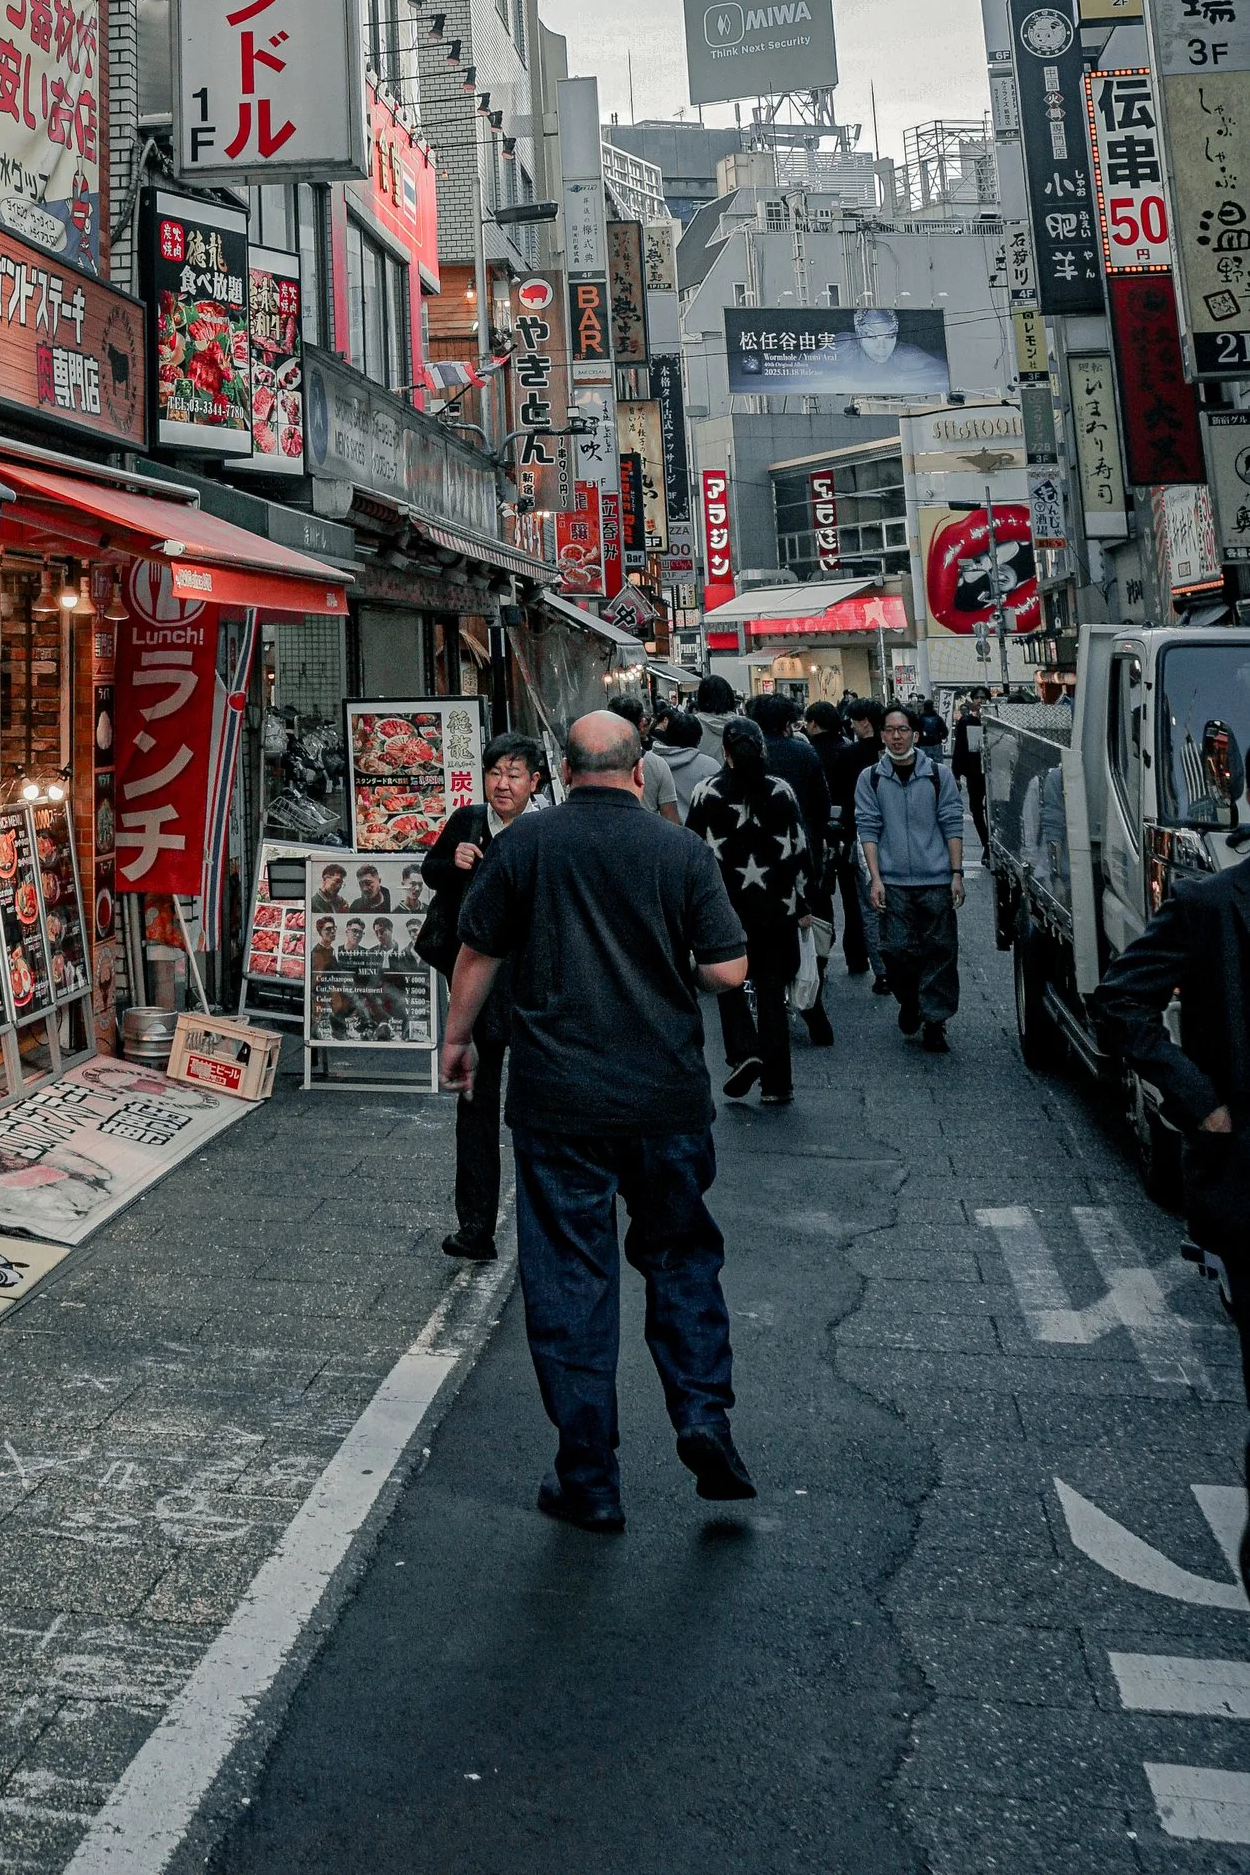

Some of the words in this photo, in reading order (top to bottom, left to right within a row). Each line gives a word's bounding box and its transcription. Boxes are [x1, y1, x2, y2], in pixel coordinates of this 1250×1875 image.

[745, 1, 813, 32] MIWA
[709, 45, 739, 60] Think
[741, 41, 766, 55] Next
[767, 34, 812, 52] Security
[1188, 39, 1229, 66] 3F
[191, 87, 217, 163] 1F
[1098, 78, 1161, 190] 伝串
[1109, 195, 1169, 247] 50
[1136, 248, 1150, 261] 円
[179, 264, 243, 306] 食べ放題
[1019, 289, 1033, 299] 4F
[576, 285, 605, 354] BAR
[739, 331, 837, 351] 松任谷由実
[515, 315, 555, 466] やきとん
[1028, 372, 1040, 381] 3F
[660, 365, 678, 485] 本格タイ古式マッサージ
[1084, 378, 1114, 505] ひまわり寿司
[1036, 453, 1049, 463] 3F
[706, 478, 730, 577] アラジン
[626, 552, 643, 564] Bar
[132, 626, 204, 646] Lunch!
[113, 650, 199, 883] ランチ
